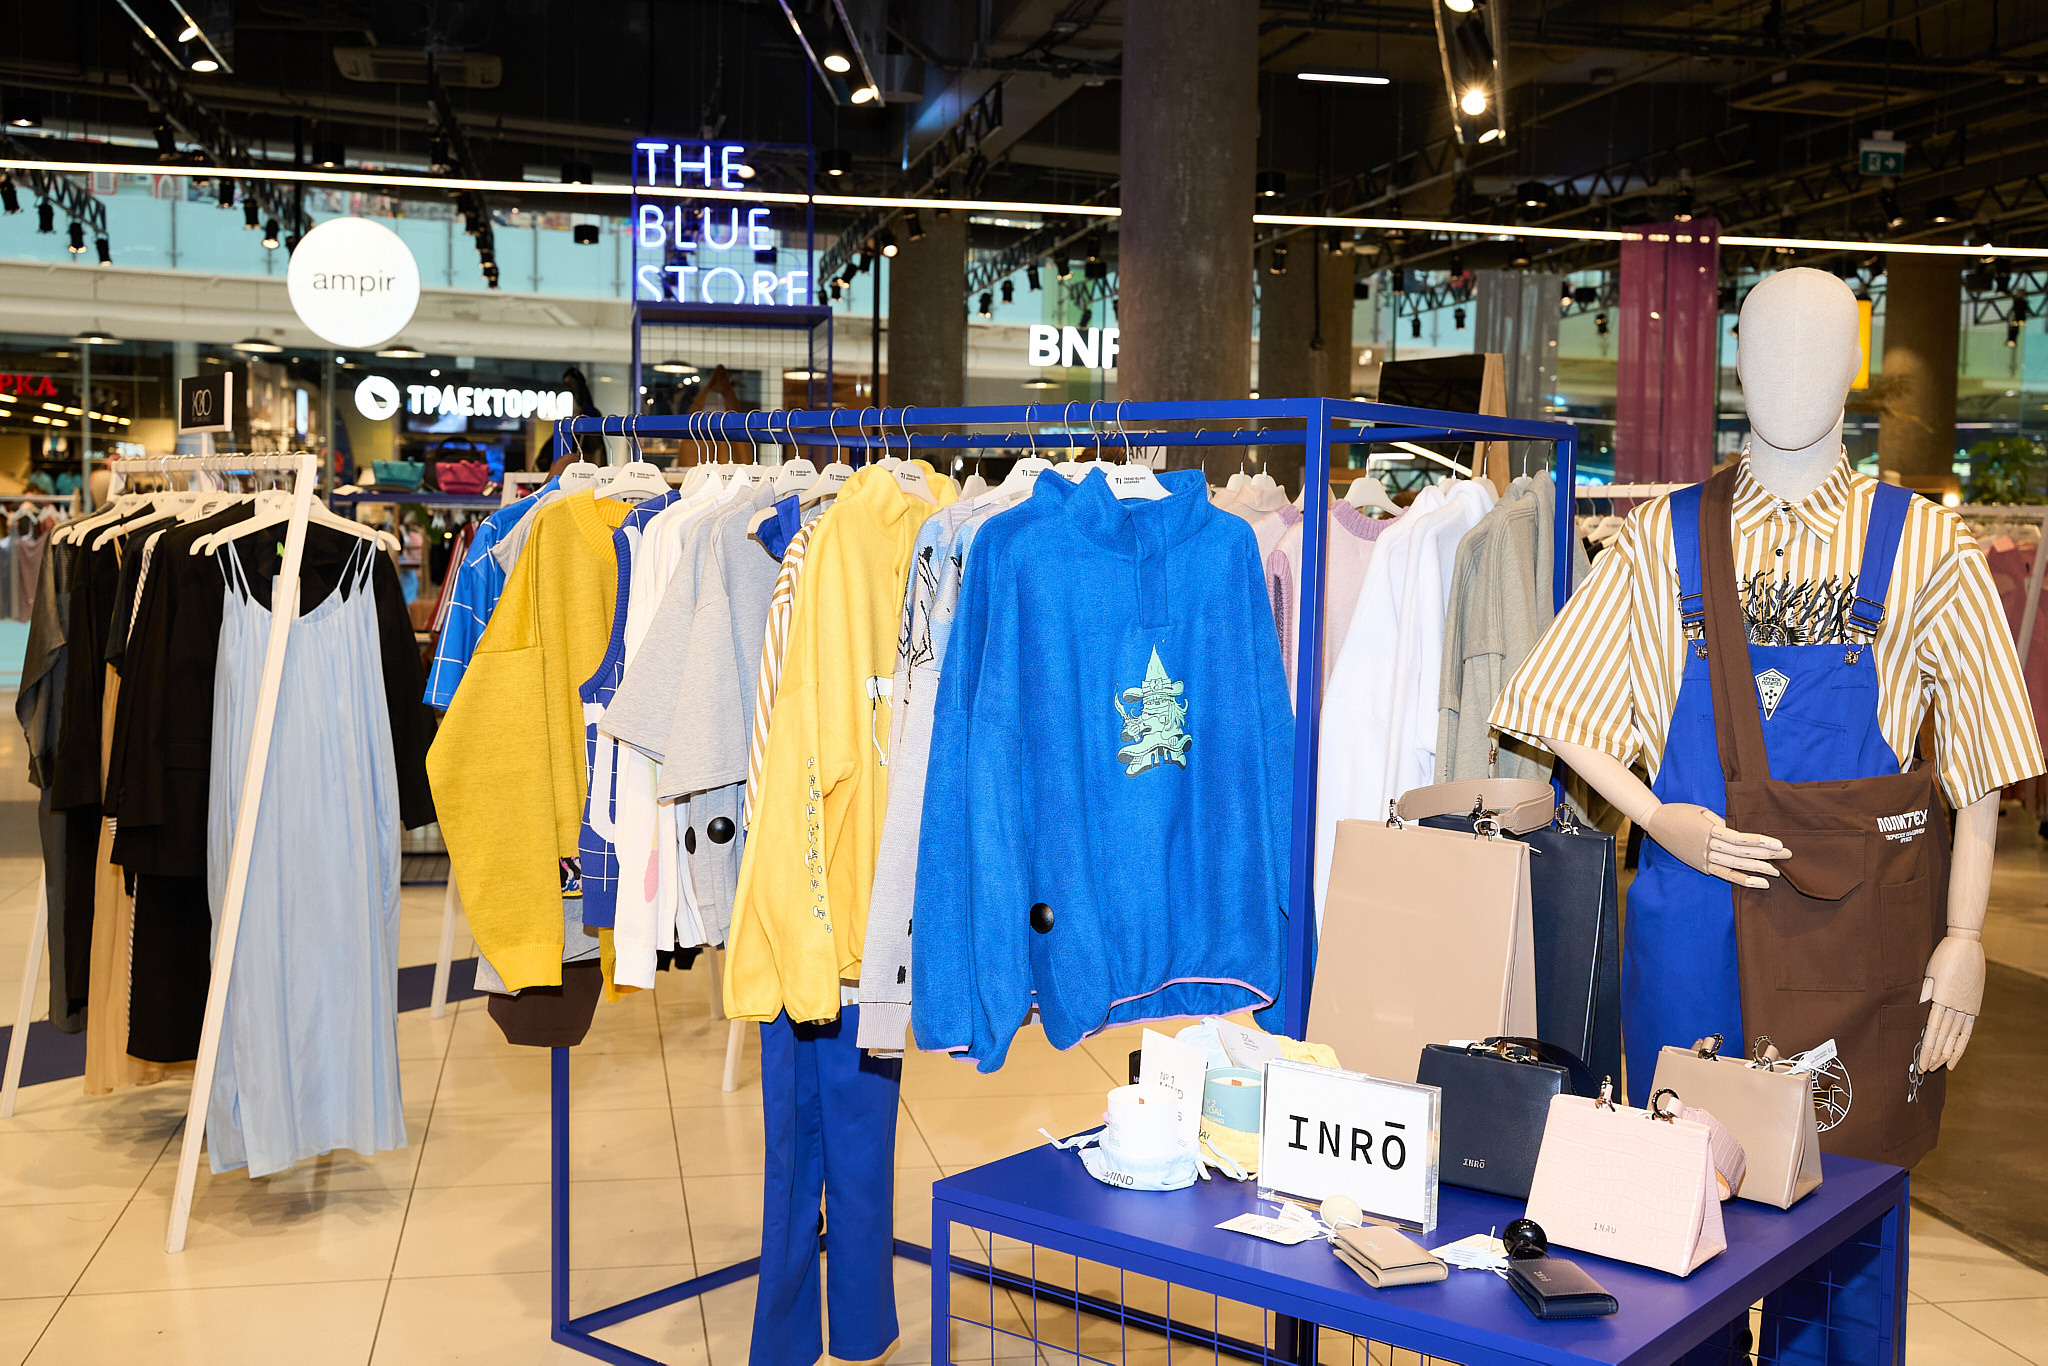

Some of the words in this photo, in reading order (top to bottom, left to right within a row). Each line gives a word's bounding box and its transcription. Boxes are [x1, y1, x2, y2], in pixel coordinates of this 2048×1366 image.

[636, 142, 745, 190] THE
[638, 204, 773, 251] BLUE
[312, 269, 396, 298] ampir
[1288, 1114, 1406, 1171] INRŌ
